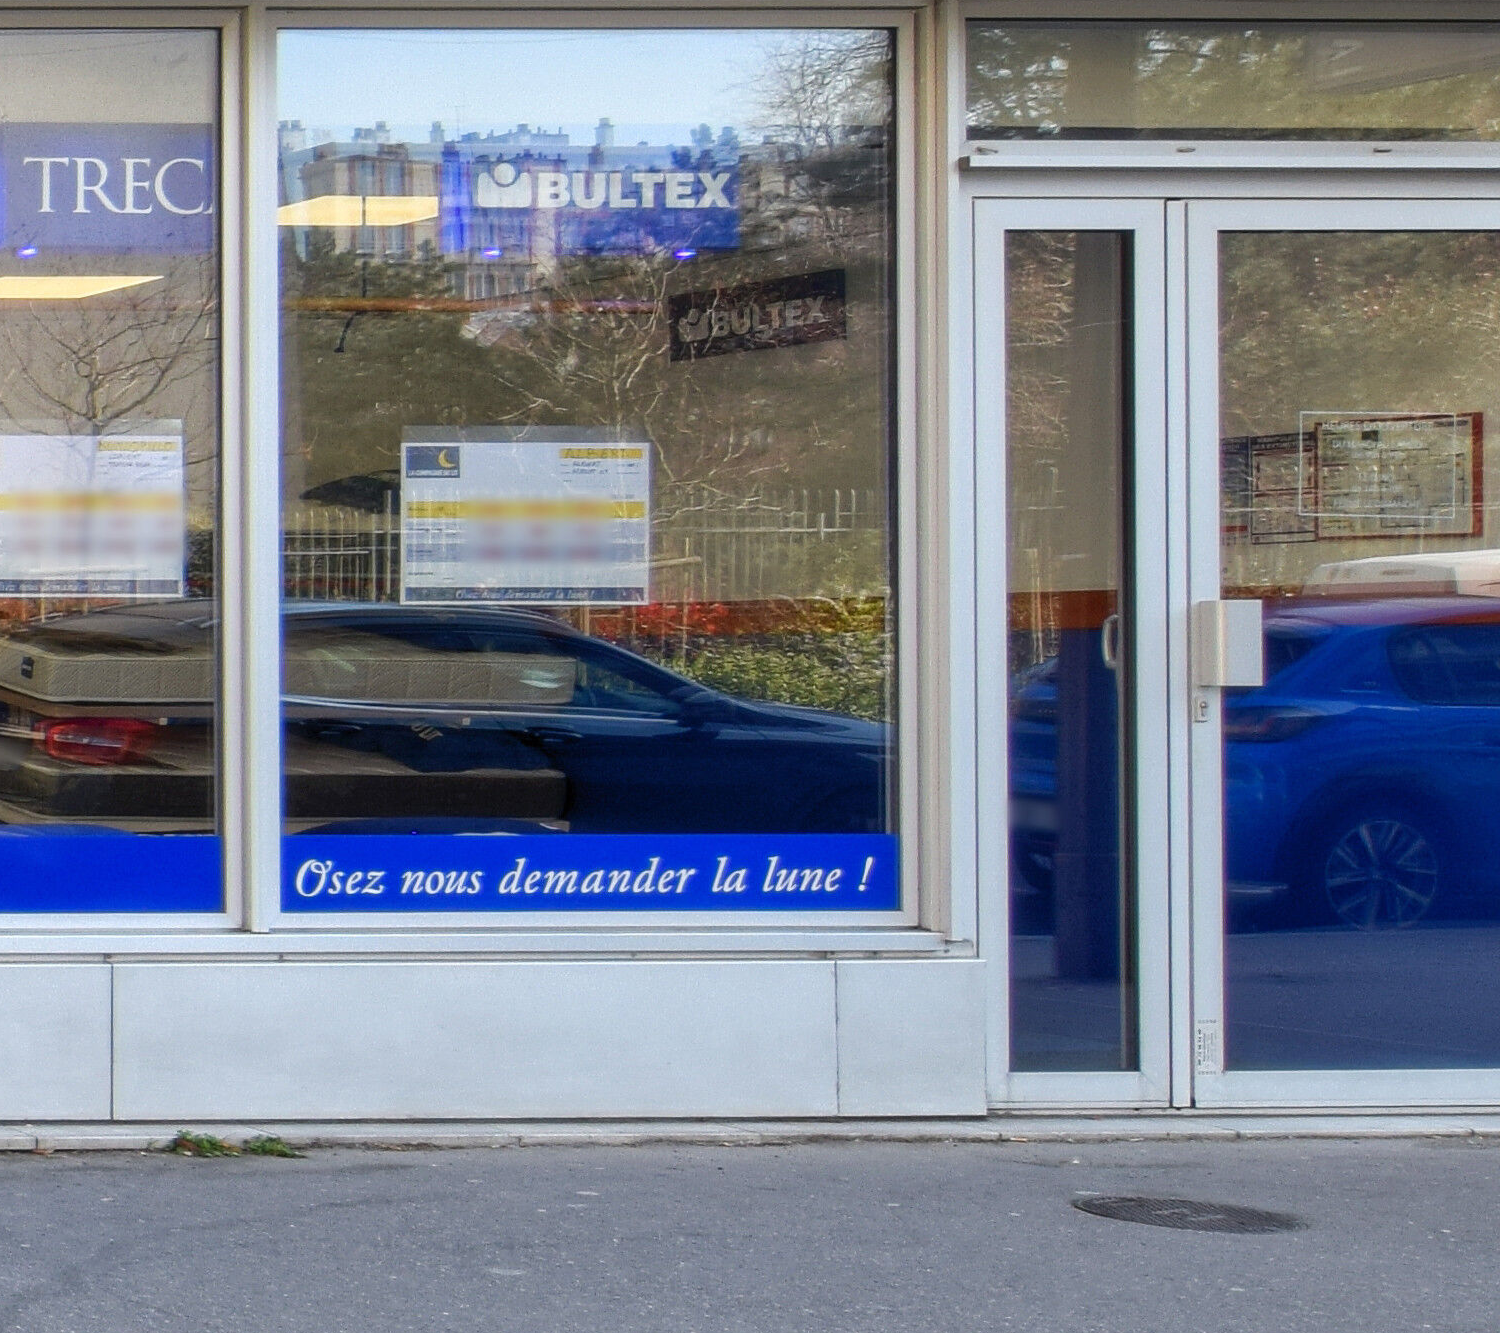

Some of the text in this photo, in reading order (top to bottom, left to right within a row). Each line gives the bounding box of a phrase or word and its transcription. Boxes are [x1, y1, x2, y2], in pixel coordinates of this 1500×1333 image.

[23, 157, 213, 215] TREC
[537, 171, 731, 209] BULTEX
[712, 295, 831, 336] BULTEX
[296, 855, 874, 898] Osez nous demander la lune !
